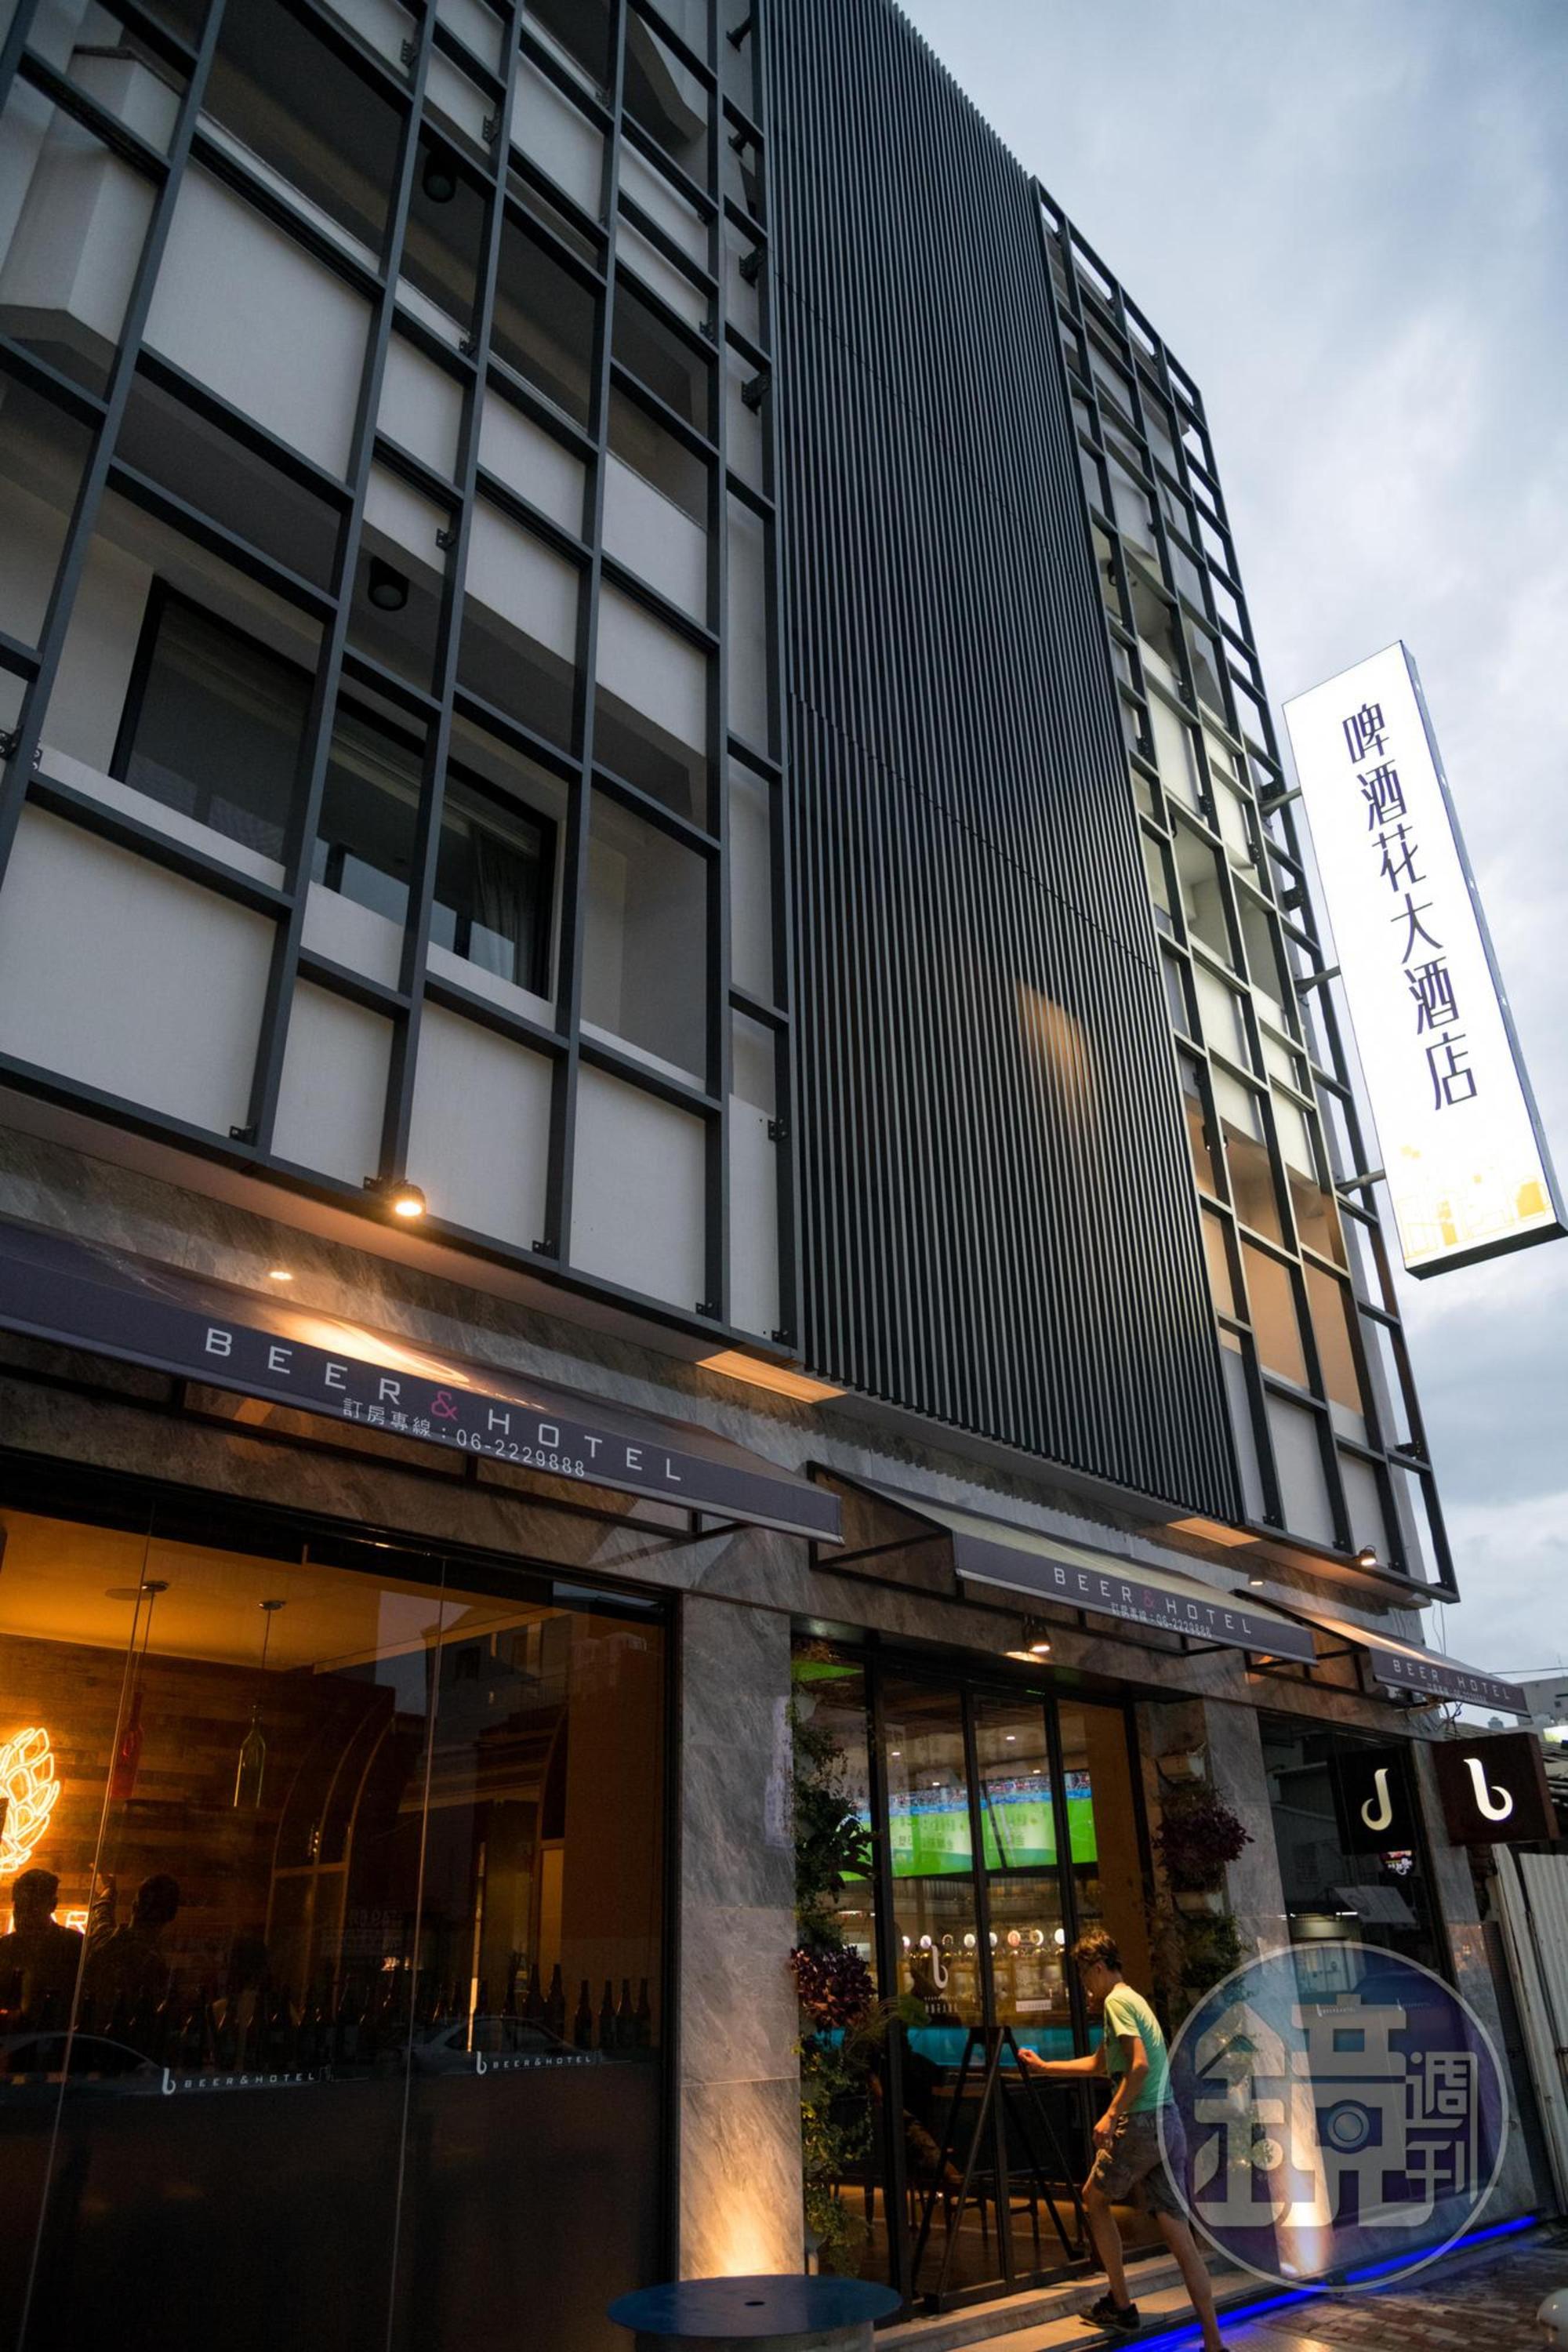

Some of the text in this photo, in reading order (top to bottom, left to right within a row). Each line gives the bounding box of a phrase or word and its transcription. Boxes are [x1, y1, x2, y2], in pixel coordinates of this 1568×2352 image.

[1341, 702, 1478, 1112] 啤酒花大酒店
